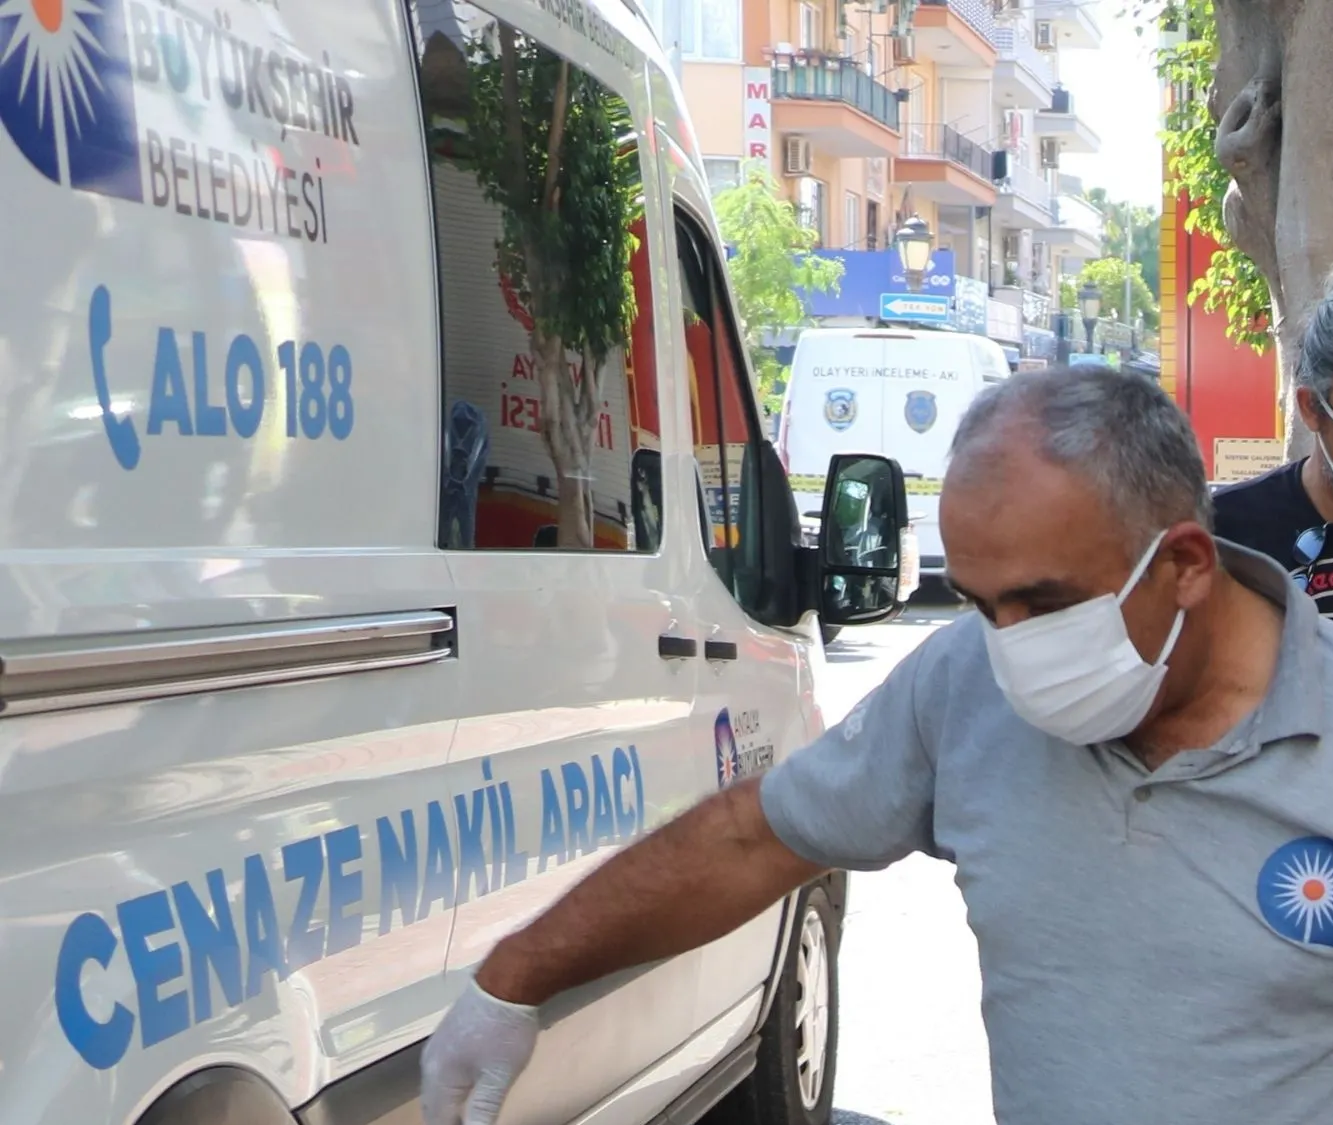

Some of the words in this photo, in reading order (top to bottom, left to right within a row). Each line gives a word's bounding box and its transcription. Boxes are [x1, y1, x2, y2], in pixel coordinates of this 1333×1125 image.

[146, 128, 328, 244] BELEDİYESİ
[147, 327, 265, 439] ALO
[278, 340, 354, 441] 188
[813, 367, 841, 377] OLAY
[56, 826, 363, 1070] CENAZE
[377, 756, 528, 937] NAKİL
[536, 745, 646, 876] ARACI
